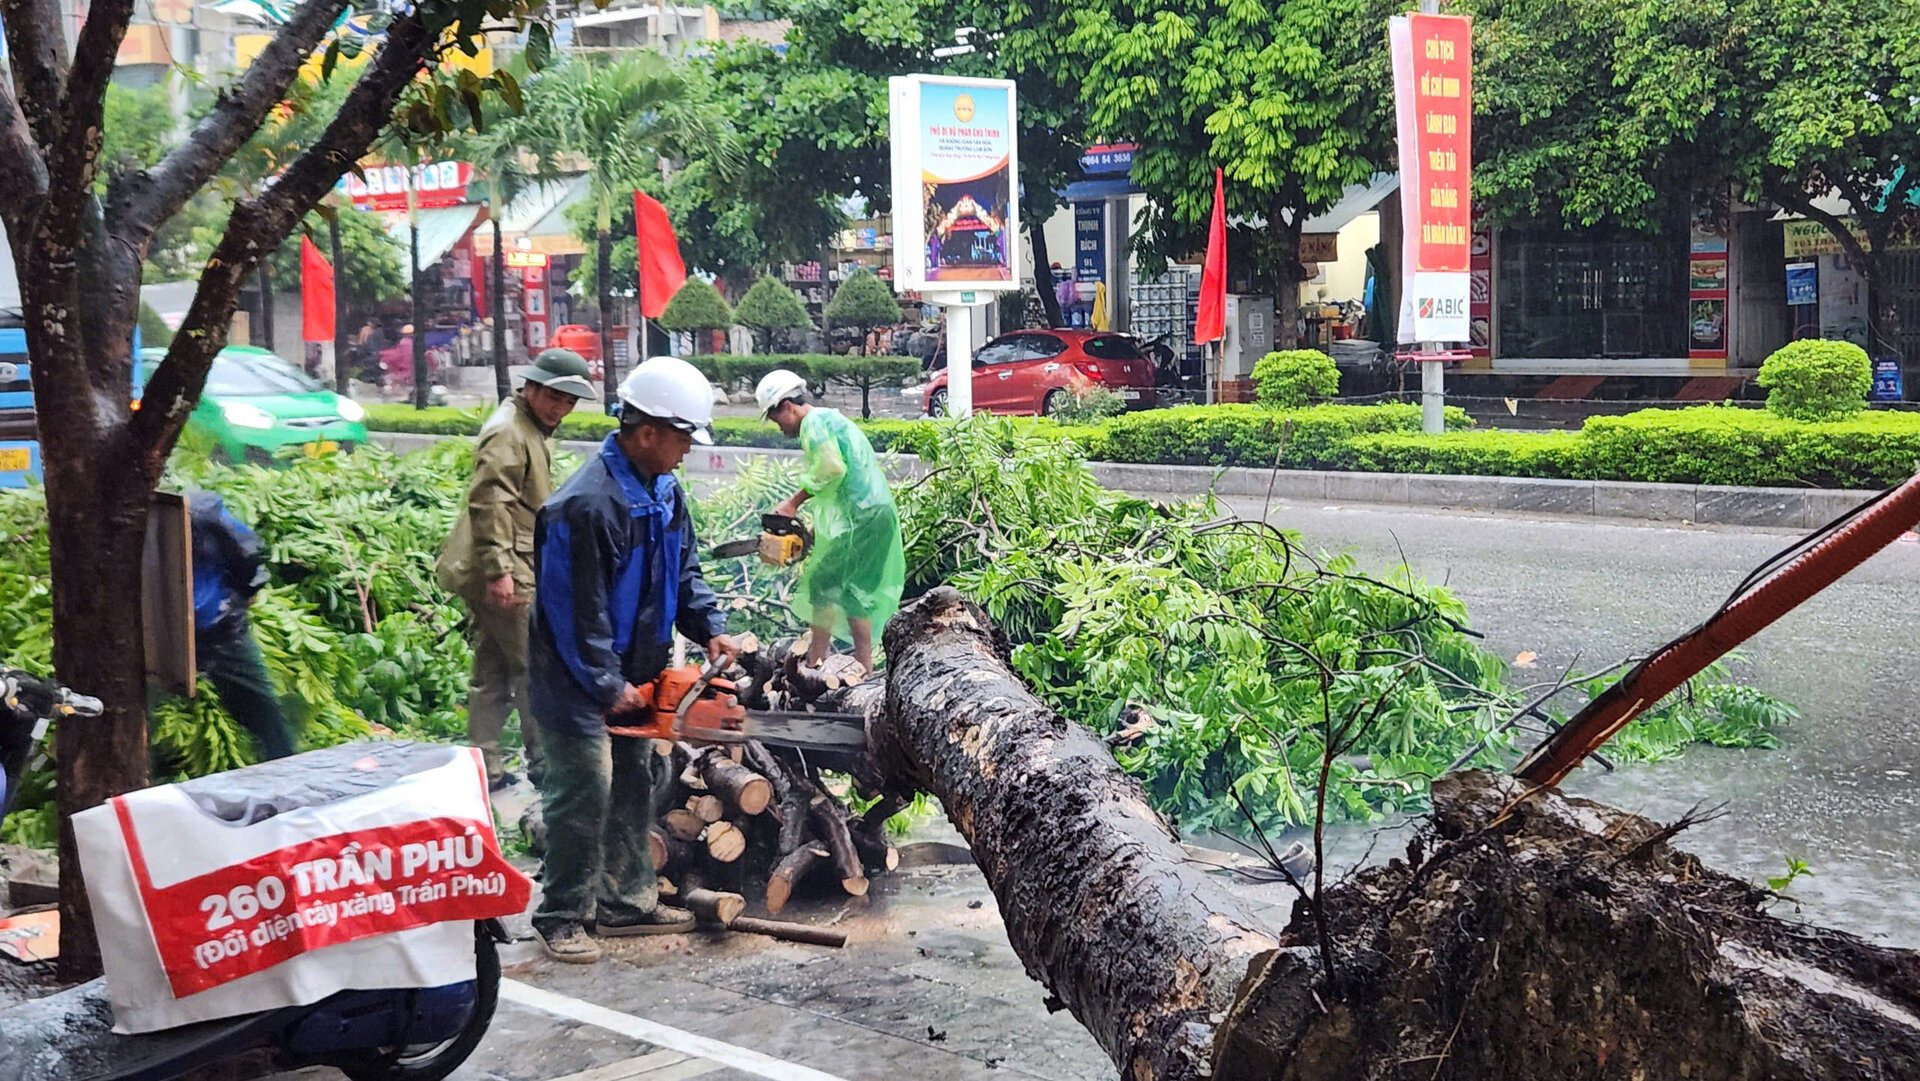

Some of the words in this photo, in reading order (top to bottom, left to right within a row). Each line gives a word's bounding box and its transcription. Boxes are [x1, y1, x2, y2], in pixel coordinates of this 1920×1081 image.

[1426, 34, 1439, 59] CHỦ
[1440, 40, 1454, 64] TỊCH
[1421, 70, 1430, 96] HỒ
[1431, 74, 1442, 96] CHÍ
[1426, 110, 1442, 133] LÃNH
[1443, 114, 1456, 138] ĐẠO
[1446, 147, 1456, 171] TÀI
[1092, 206, 1101, 214] TY
[1078, 220, 1098, 233] THỊNH
[1080, 238, 1097, 251] BÍCH
[1083, 258, 1093, 267] 91
[1435, 298, 1464, 315] ABIC
[201, 876, 285, 931] 260
[290, 842, 392, 897] TRẦN
[401, 826, 484, 877] PHÚ
[194, 926, 249, 969] (Đối
[250, 912, 304, 947] diện
[304, 898, 337, 927] cây
[341, 889, 395, 917] xăng
[397, 879, 446, 907] Trần
[452, 871, 506, 897] Phú)
